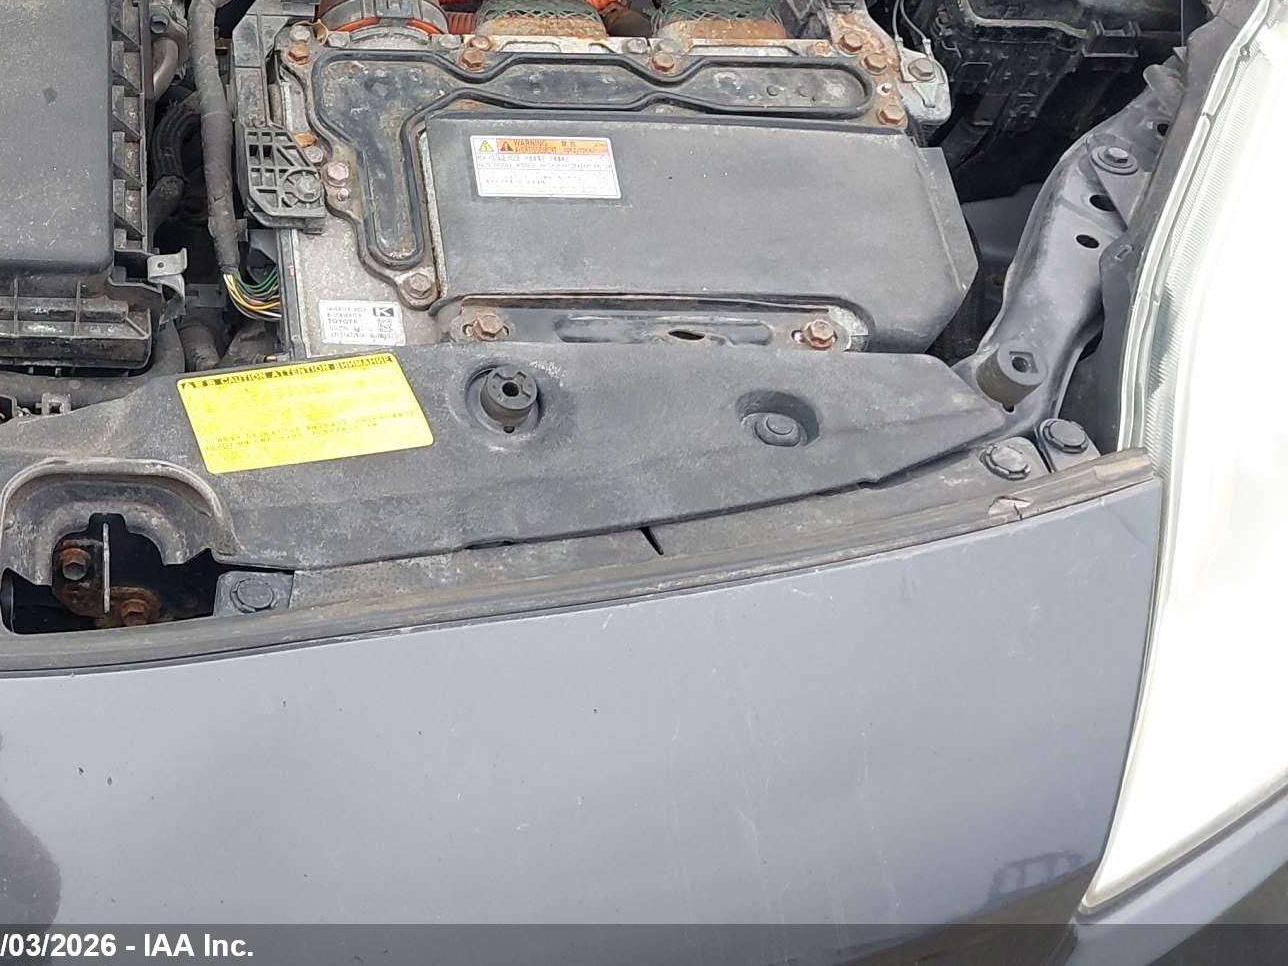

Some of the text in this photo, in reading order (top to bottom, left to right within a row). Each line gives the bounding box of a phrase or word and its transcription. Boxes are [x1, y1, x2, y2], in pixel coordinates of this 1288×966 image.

[513, 138, 548, 147] WARNING
[220, 371, 266, 385] CAUTION
[271, 363, 329, 378] ATTENTION
